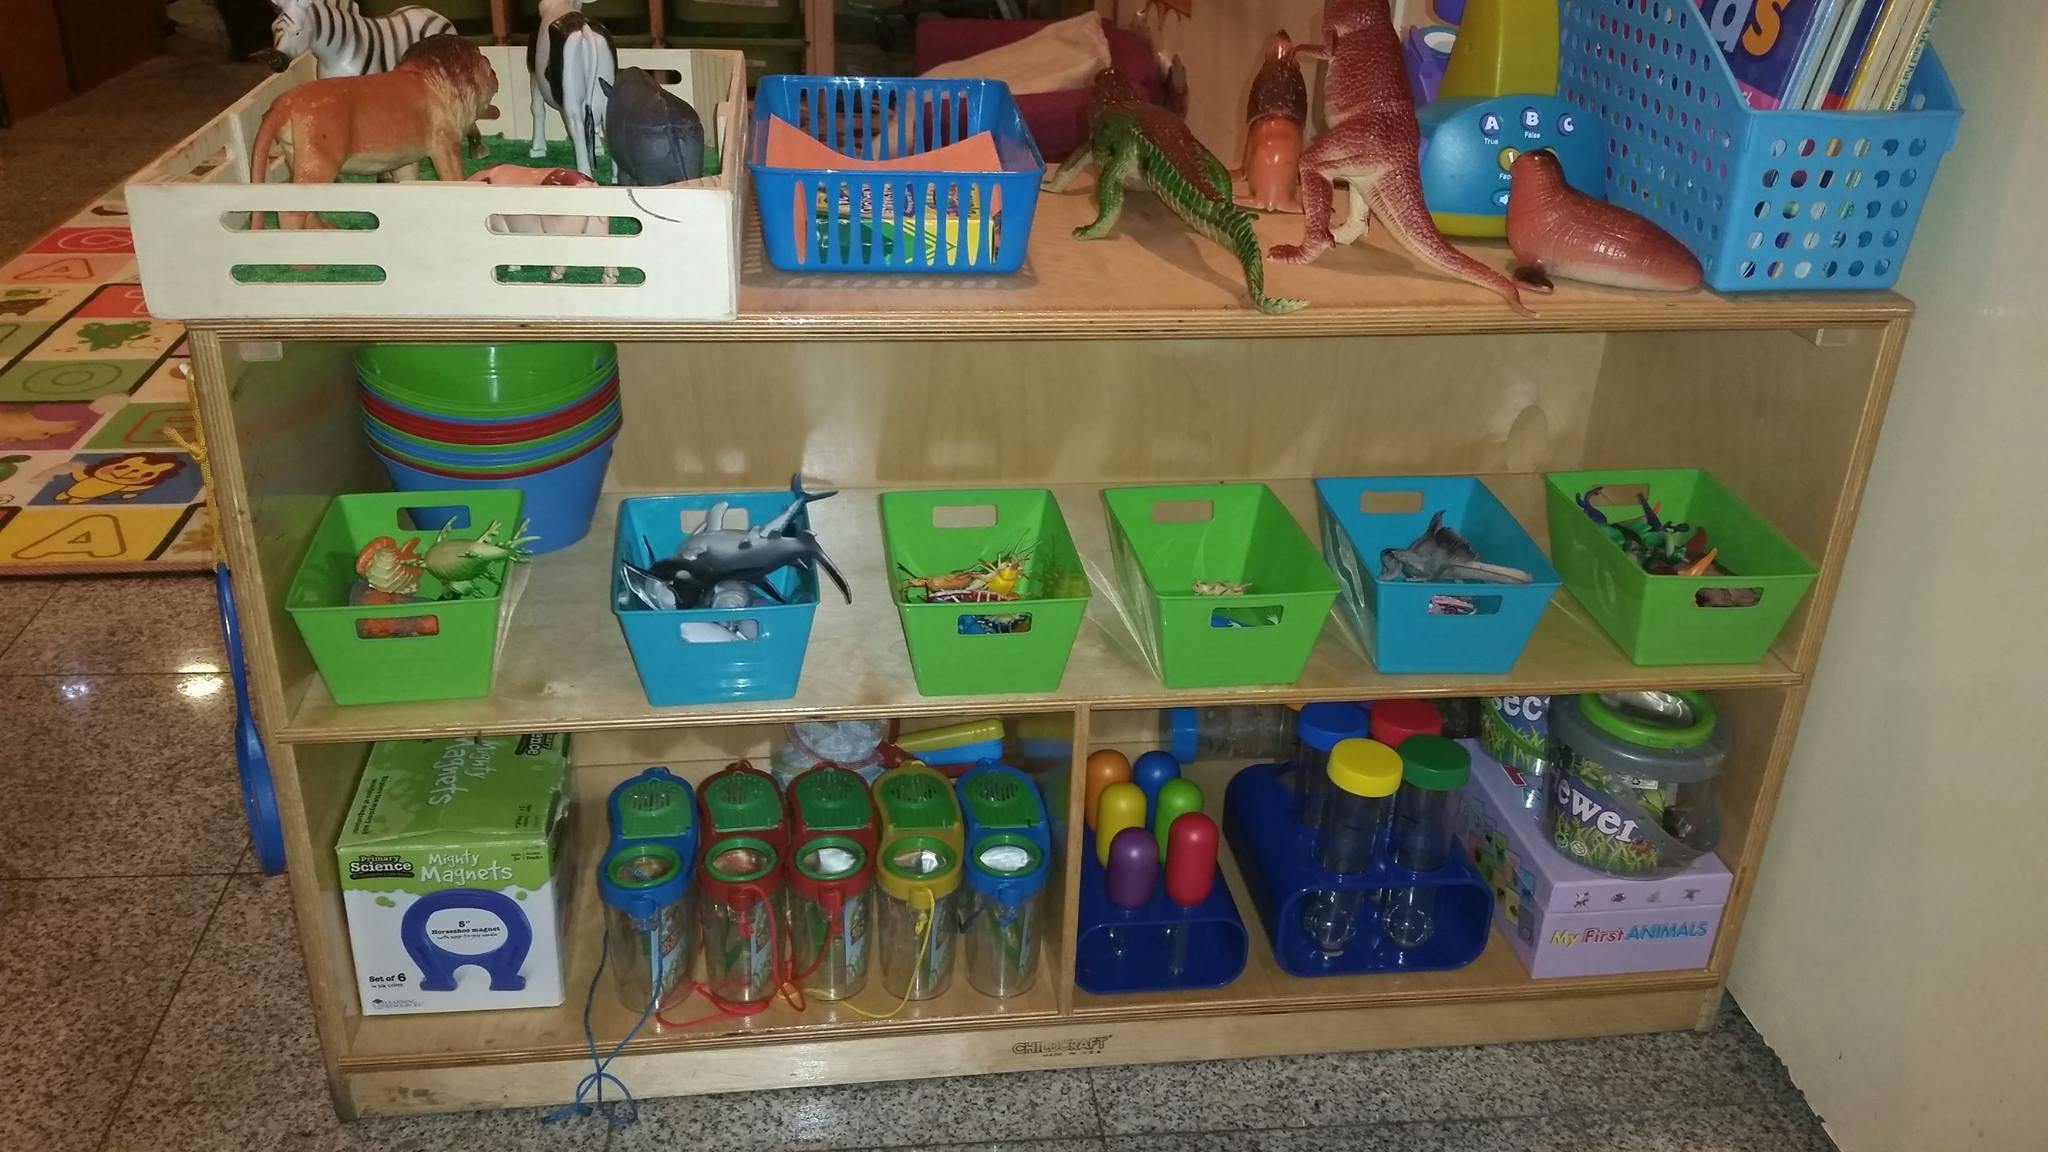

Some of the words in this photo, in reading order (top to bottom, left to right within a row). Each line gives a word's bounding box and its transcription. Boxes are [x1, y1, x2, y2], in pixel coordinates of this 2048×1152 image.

[1485, 116, 1500, 130] A
[1526, 112, 1539, 126] B
[1563, 117, 1575, 132] C
[1524, 131, 1541, 139] False
[11, 514, 127, 560] A
[350, 861, 412, 872] Science
[428, 848, 480, 867] Mighty
[421, 860, 513, 886] Magnets
[1550, 928, 1579, 948] My
[1583, 928, 1625, 944] First
[1627, 920, 1709, 941] ANIMALS
[397, 972, 407, 982] 6
[1012, 1035, 1113, 1055] CHILDCRAFT
